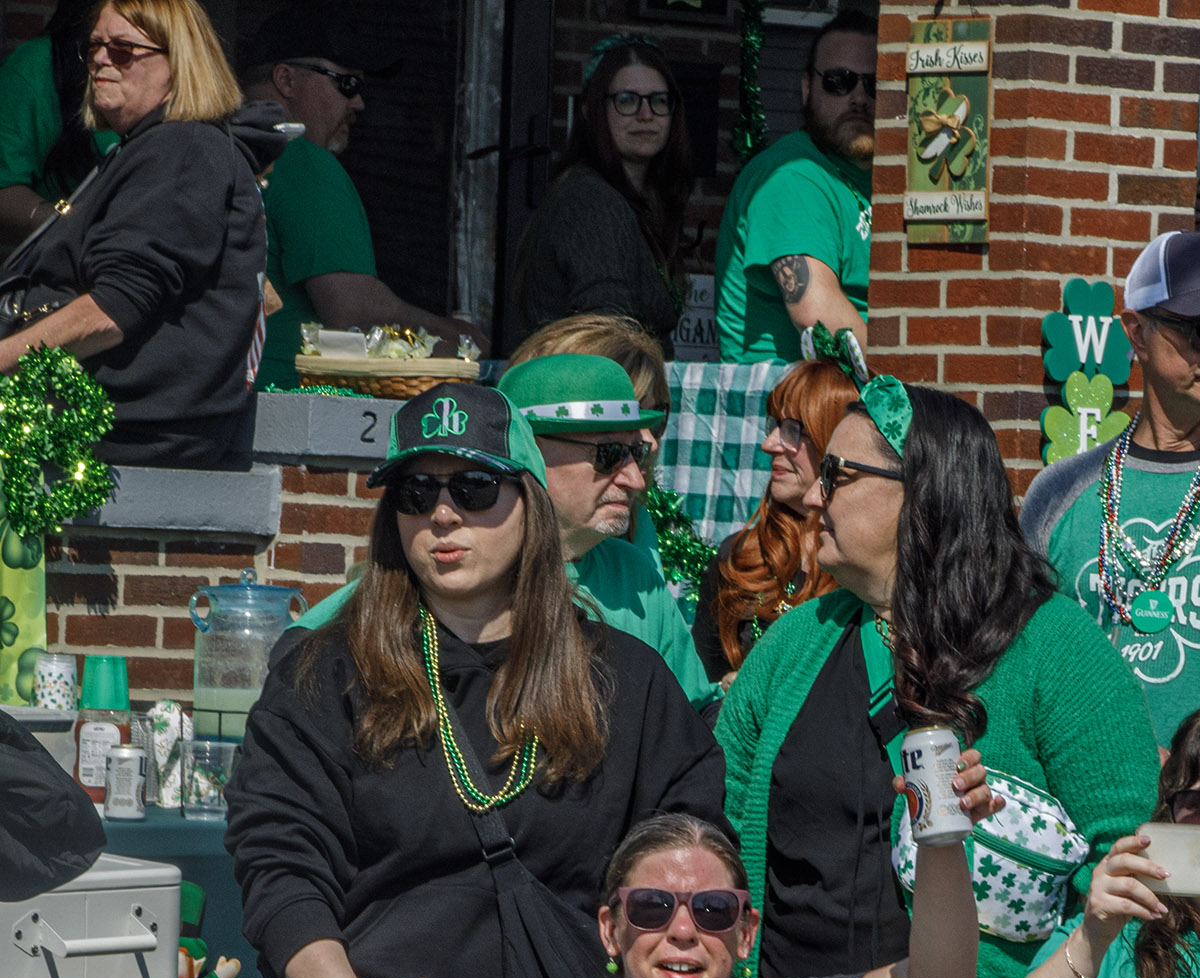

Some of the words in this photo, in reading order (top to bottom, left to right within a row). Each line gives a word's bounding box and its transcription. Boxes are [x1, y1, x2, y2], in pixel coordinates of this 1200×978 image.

[909, 48, 942, 71] Irish
[946, 44, 984, 69] Kisses
[907, 196, 949, 217] Shamrock
[951, 192, 983, 214] Wishes
[361, 410, 377, 443] 2
[1134, 608, 1169, 619] GUINNESS
[1121, 641, 1164, 662] 1901
